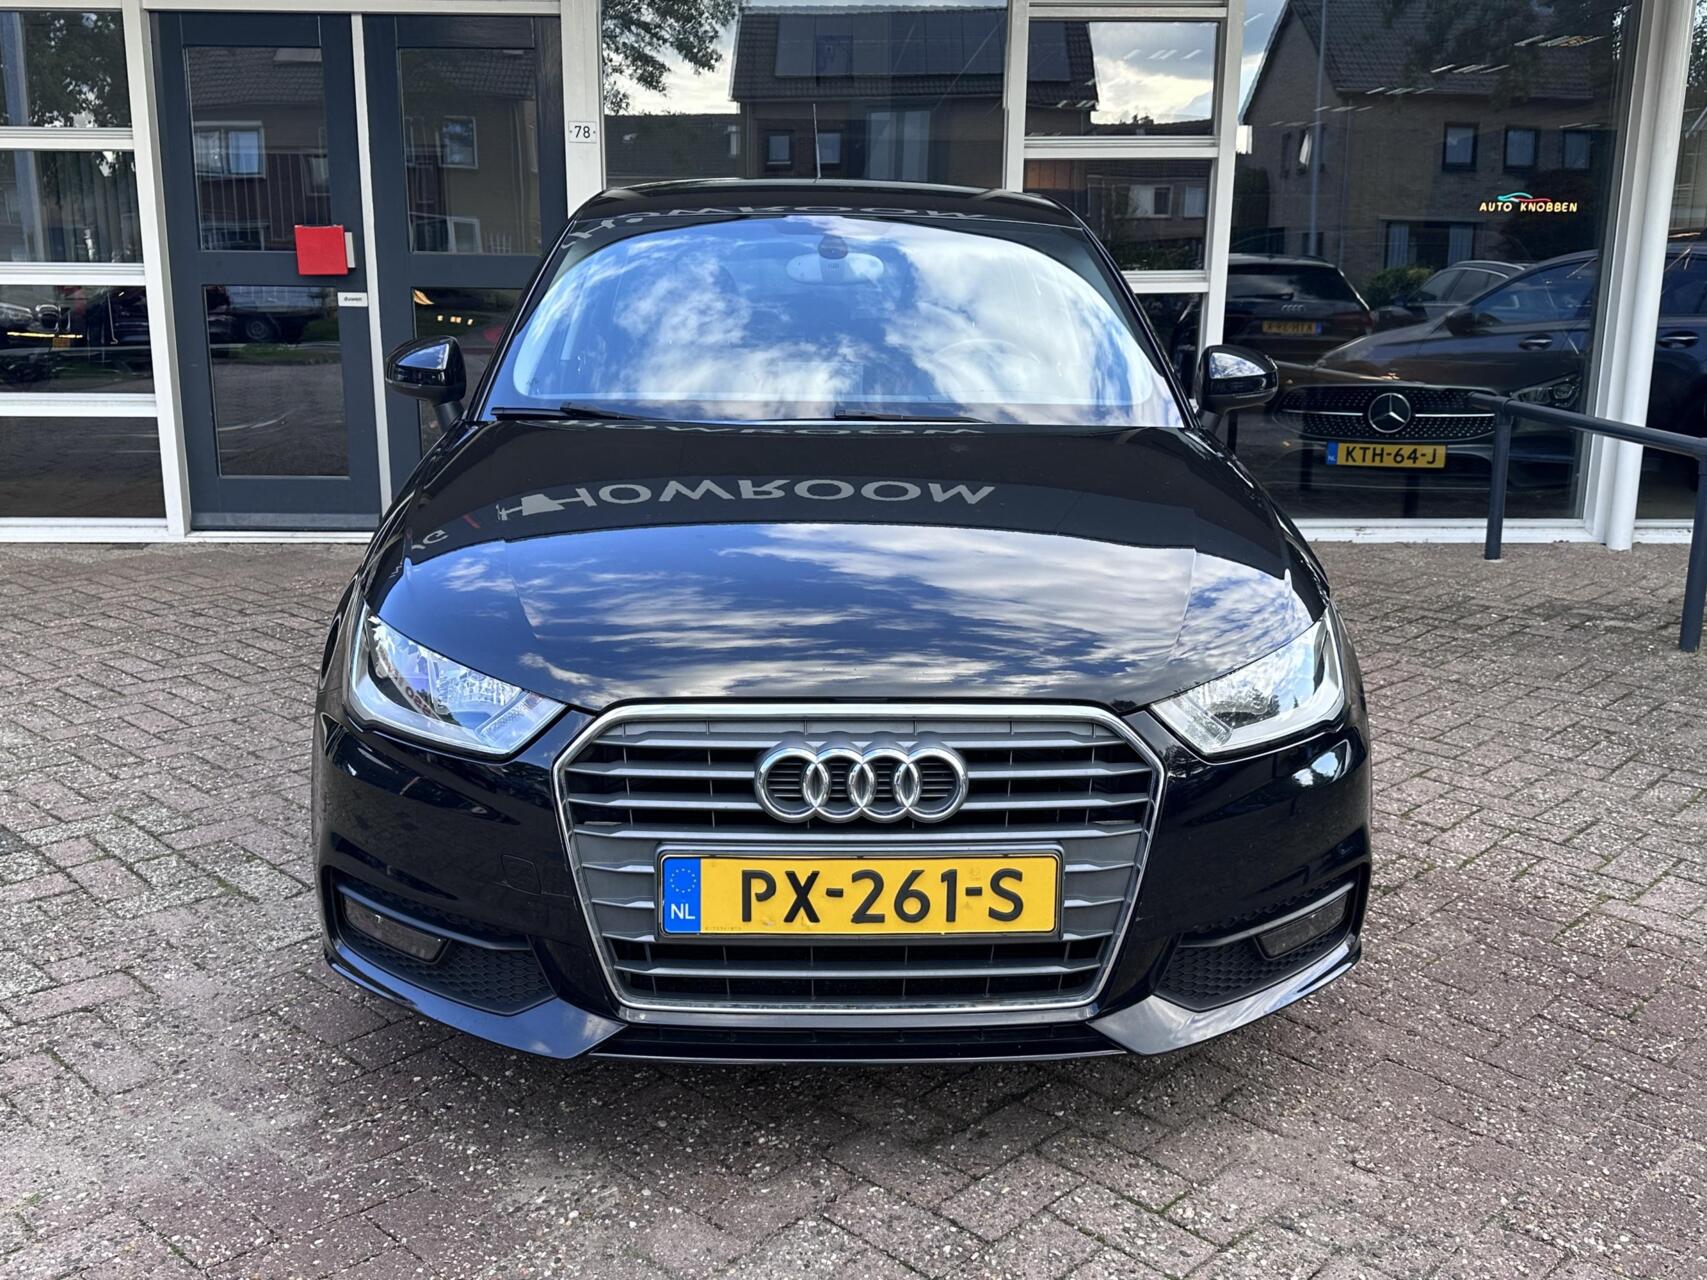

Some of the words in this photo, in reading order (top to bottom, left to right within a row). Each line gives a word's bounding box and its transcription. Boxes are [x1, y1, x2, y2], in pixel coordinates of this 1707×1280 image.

[574, 125, 591, 139] 78
[1479, 202, 1513, 212] AUTO
[1520, 202, 1578, 212] KNOBBEN
[1345, 446, 1437, 465] KTH-64-J
[741, 869, 1024, 923] PX-261-S
[671, 903, 696, 919] NL
